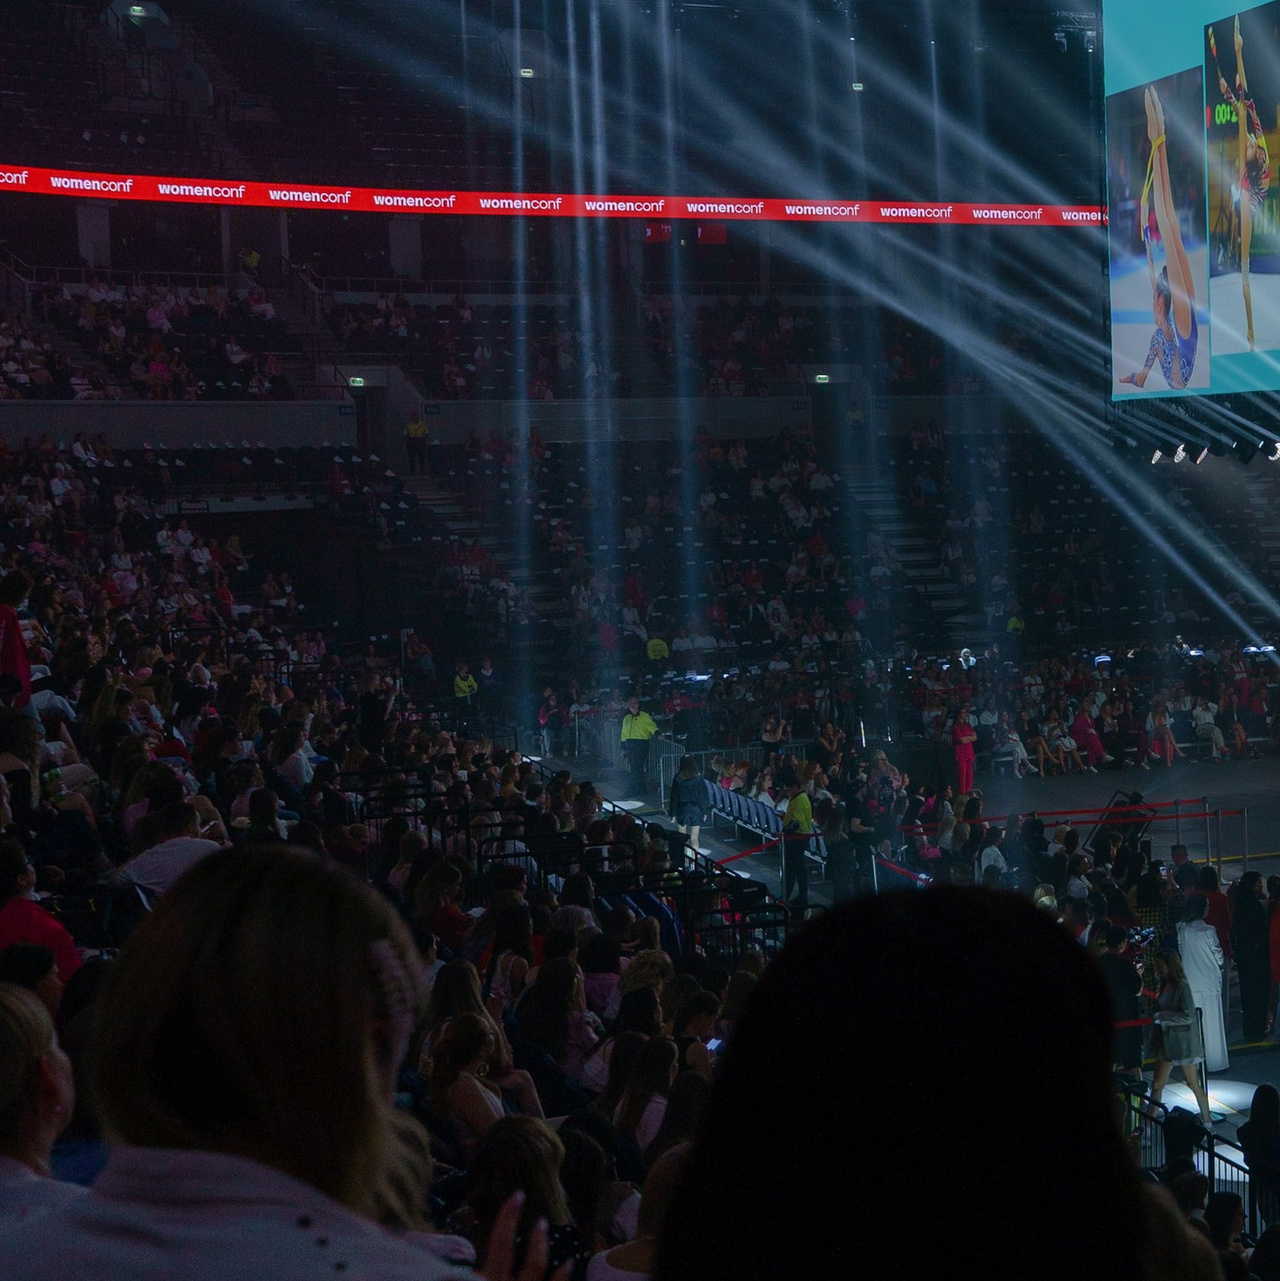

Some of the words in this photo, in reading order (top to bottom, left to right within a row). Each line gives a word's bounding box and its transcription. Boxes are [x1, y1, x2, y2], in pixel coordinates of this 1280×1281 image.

[50, 176, 133, 192] womenconf
[158, 183, 246, 199] womenconf
[269, 187, 351, 204] womenconf
[373, 194, 456, 208] womenconf
[480, 197, 562, 211] womenconf
[584, 199, 665, 213] womenconf
[686, 201, 764, 214] womenconf
[785, 204, 860, 217] womenconf
[880, 206, 953, 218] womenconf
[972, 207, 1043, 220] womenconf
